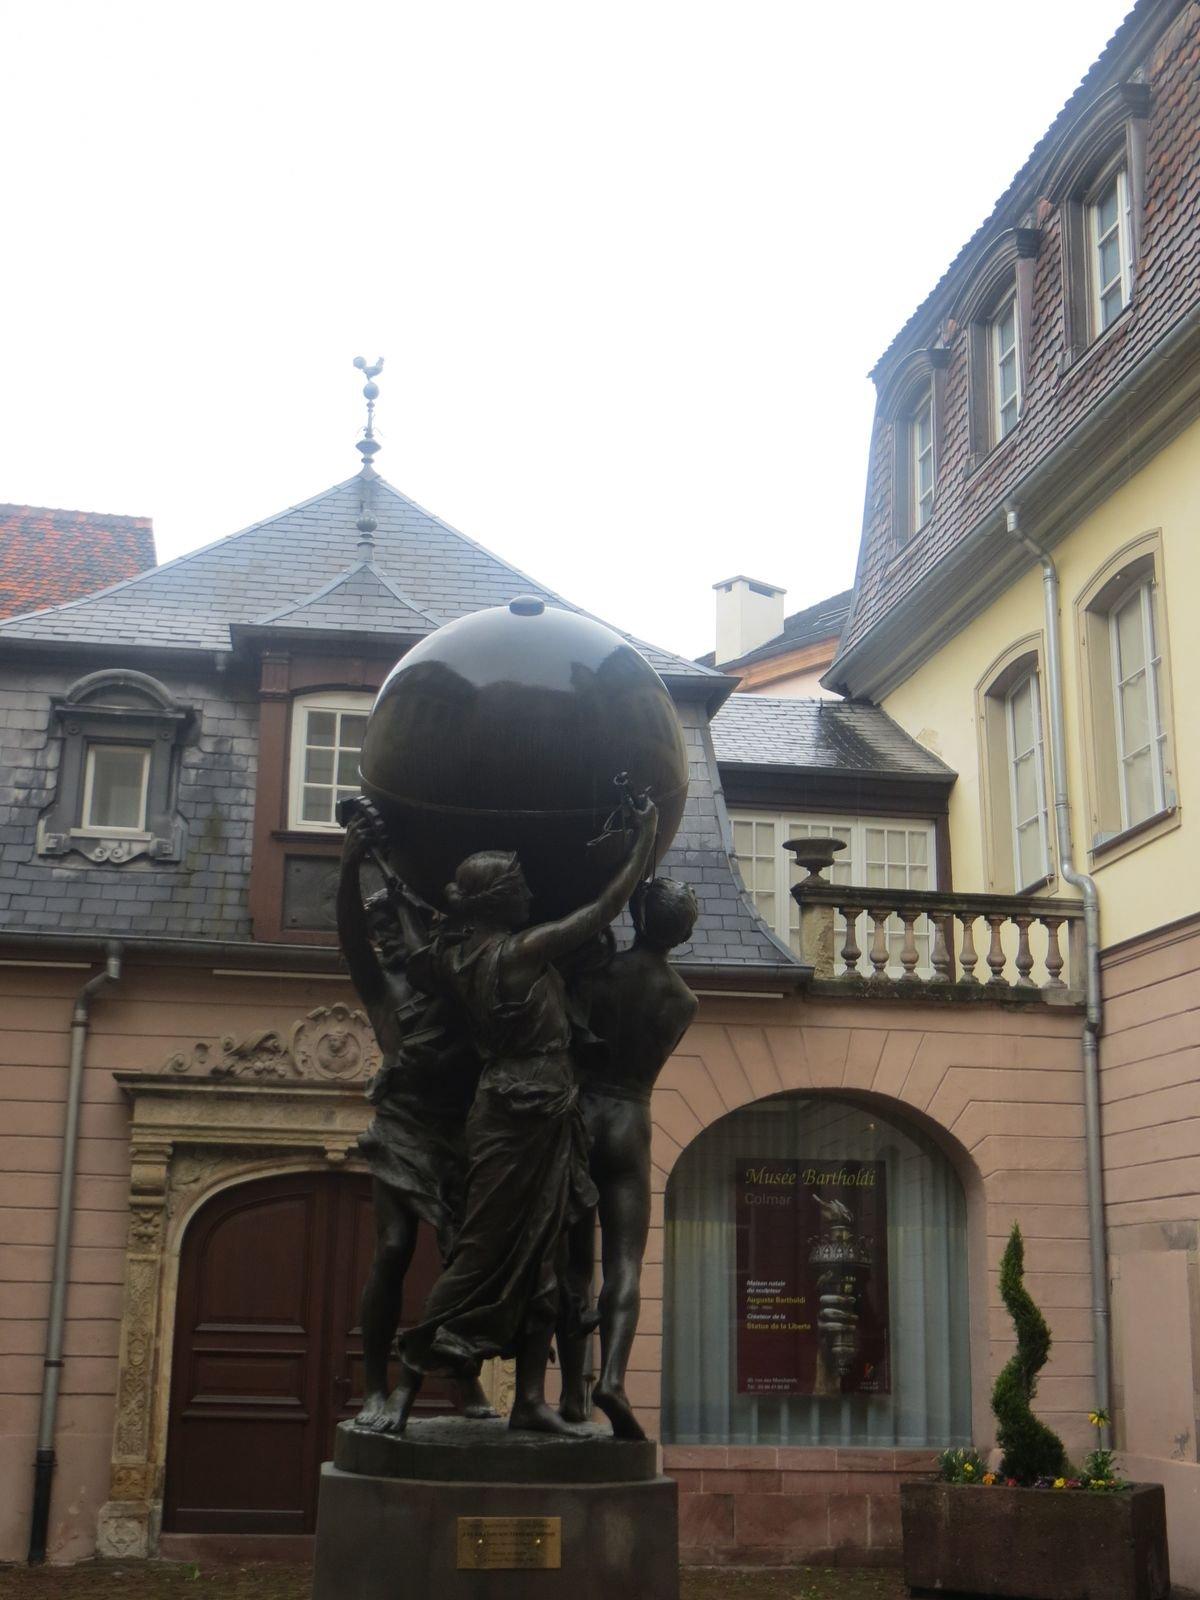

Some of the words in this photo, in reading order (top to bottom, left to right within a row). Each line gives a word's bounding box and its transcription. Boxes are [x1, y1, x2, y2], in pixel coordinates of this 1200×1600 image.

[745, 1166, 797, 1185] Musée
[801, 1167, 877, 1186] Bartholdi
[744, 1193, 792, 1205] Colmar
[746, 1296, 774, 1304] Auguste
